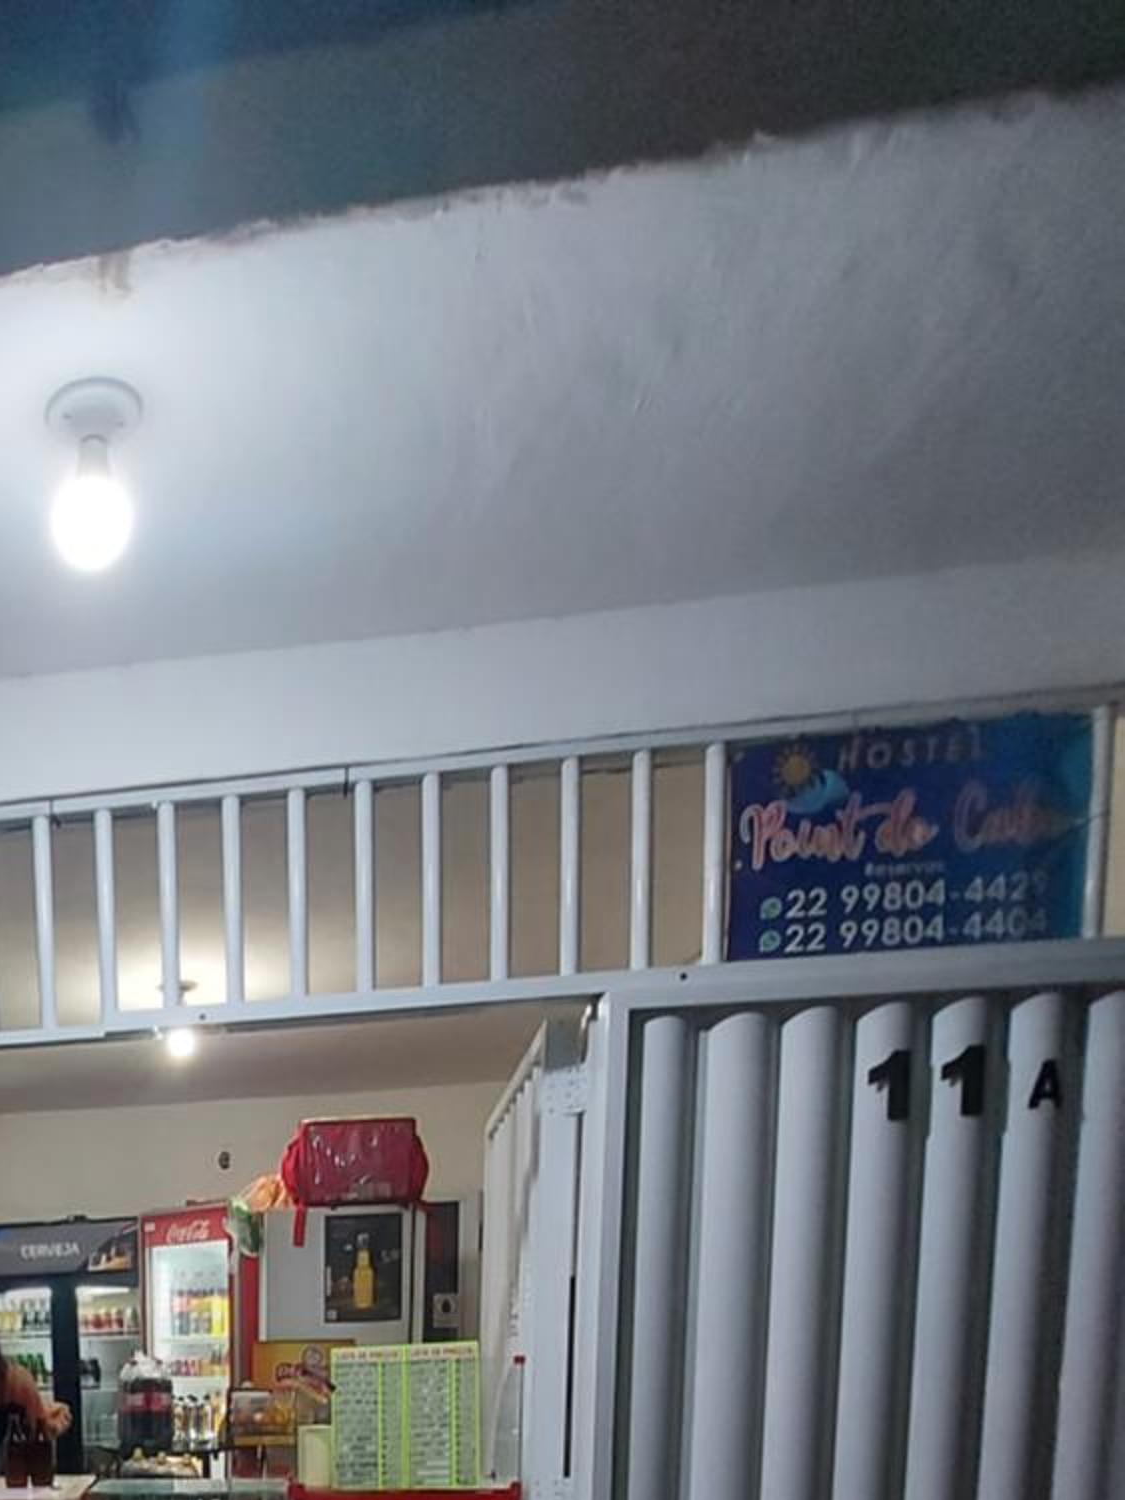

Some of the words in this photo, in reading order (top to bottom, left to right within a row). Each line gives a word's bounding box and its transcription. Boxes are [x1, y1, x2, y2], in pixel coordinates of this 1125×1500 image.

[740, 791, 867, 871] Point
[785, 887, 827, 919] 22
[784, 923, 826, 954] 22
[20, 1241, 81, 1260] CERVEJA
